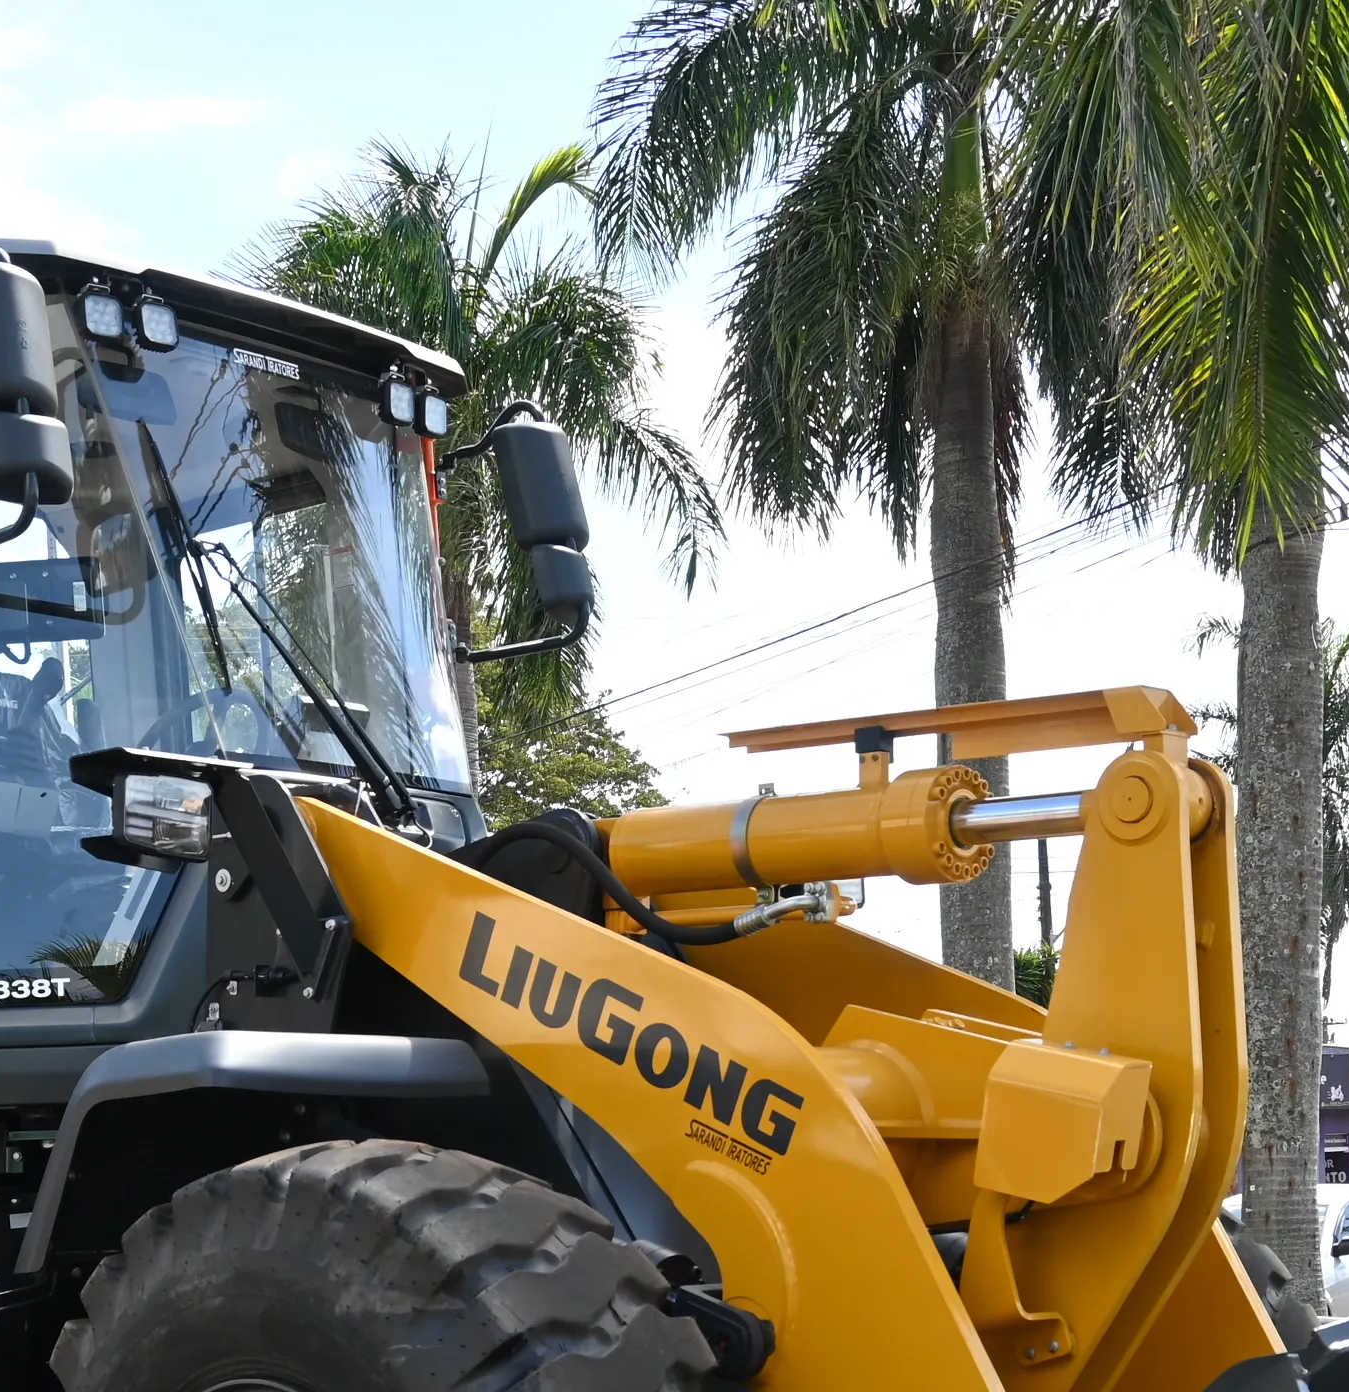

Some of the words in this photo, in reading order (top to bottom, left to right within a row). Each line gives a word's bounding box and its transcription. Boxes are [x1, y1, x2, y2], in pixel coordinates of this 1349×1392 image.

[233, 348, 266, 371] SARANDI
[265, 356, 300, 380] TRATORES
[459, 910, 805, 1156] LIUGONG
[685, 1119, 729, 1154] SARANDI
[726, 1138, 773, 1176] TRATORES
